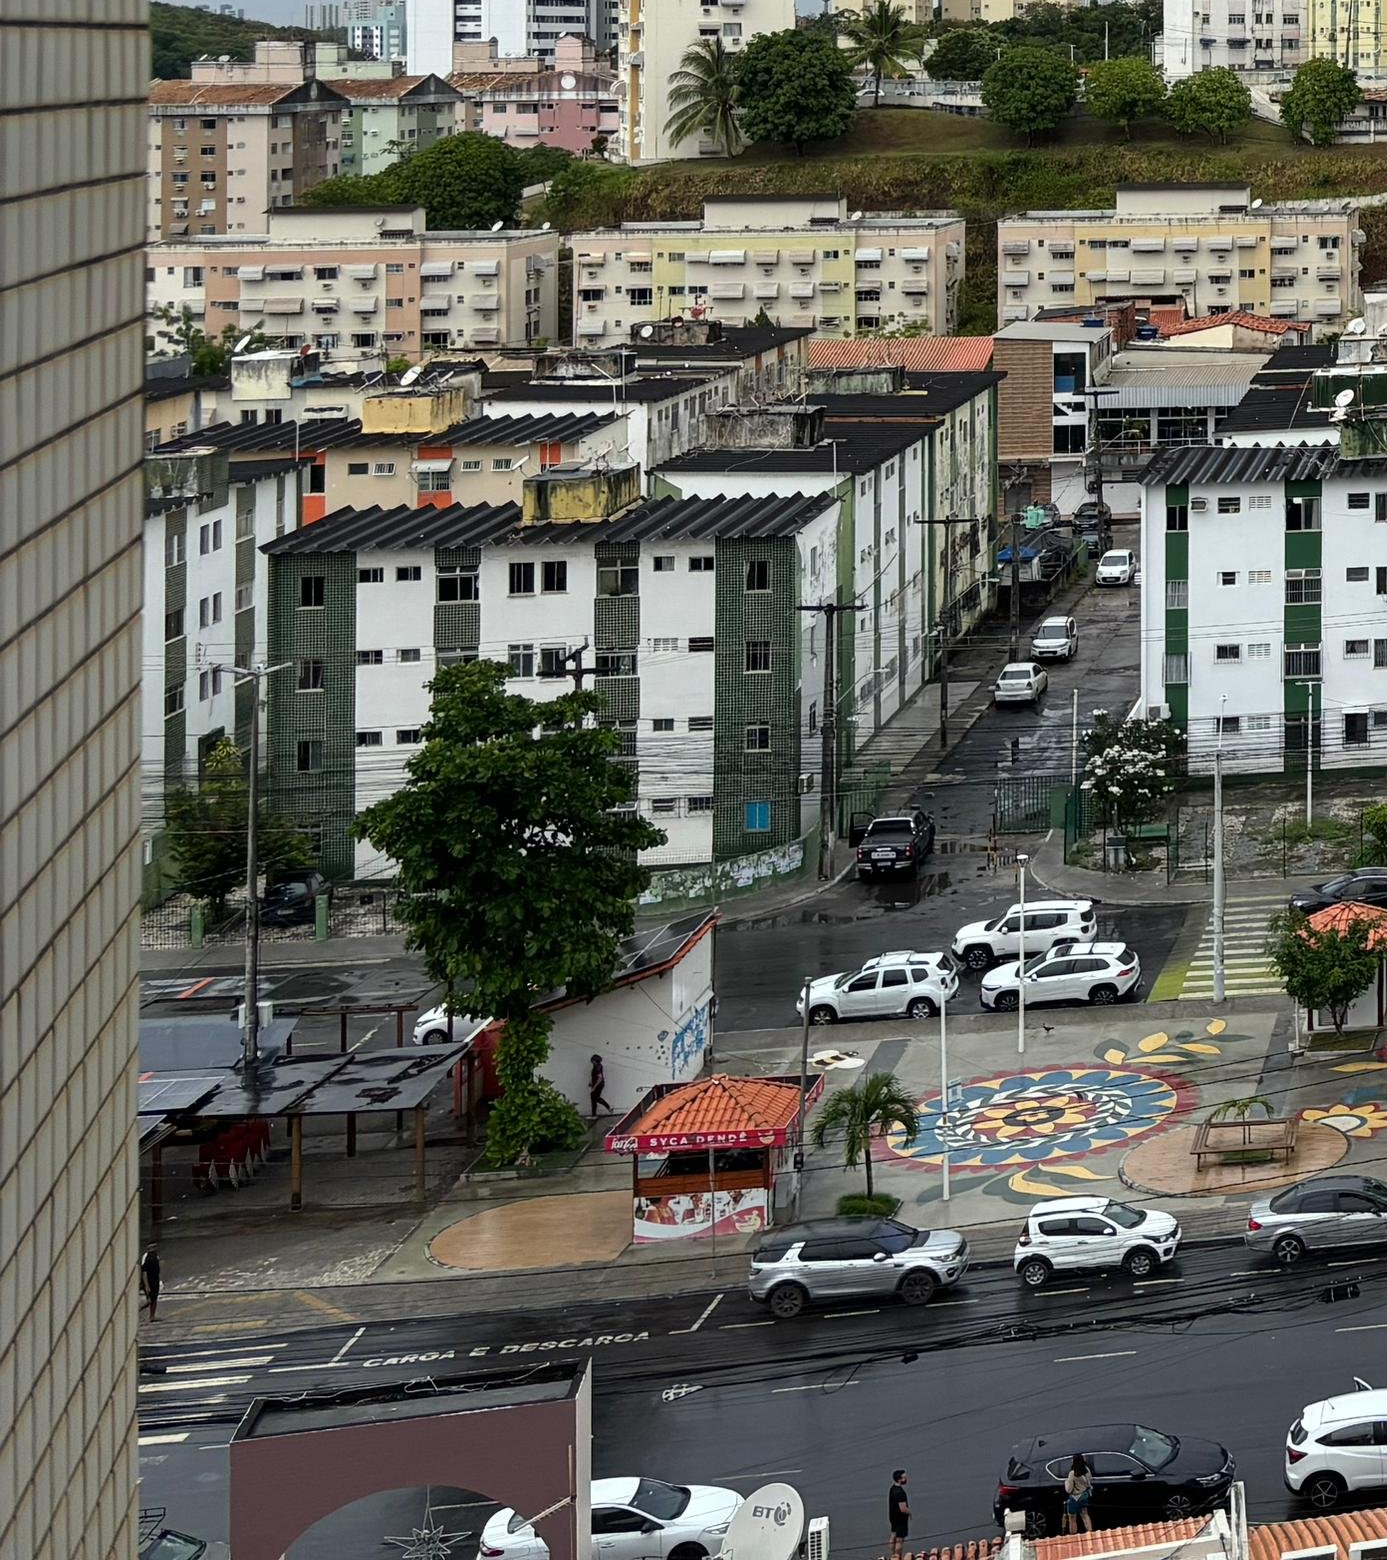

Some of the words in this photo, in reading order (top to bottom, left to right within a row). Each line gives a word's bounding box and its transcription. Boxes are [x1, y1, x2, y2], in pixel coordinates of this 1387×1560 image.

[649, 1136, 689, 1147] SYCA
[363, 1349, 455, 1368] CARGA
[469, 1346, 488, 1357] E
[499, 1331, 650, 1355] DESCARGA
[752, 1505, 775, 1519] BT
